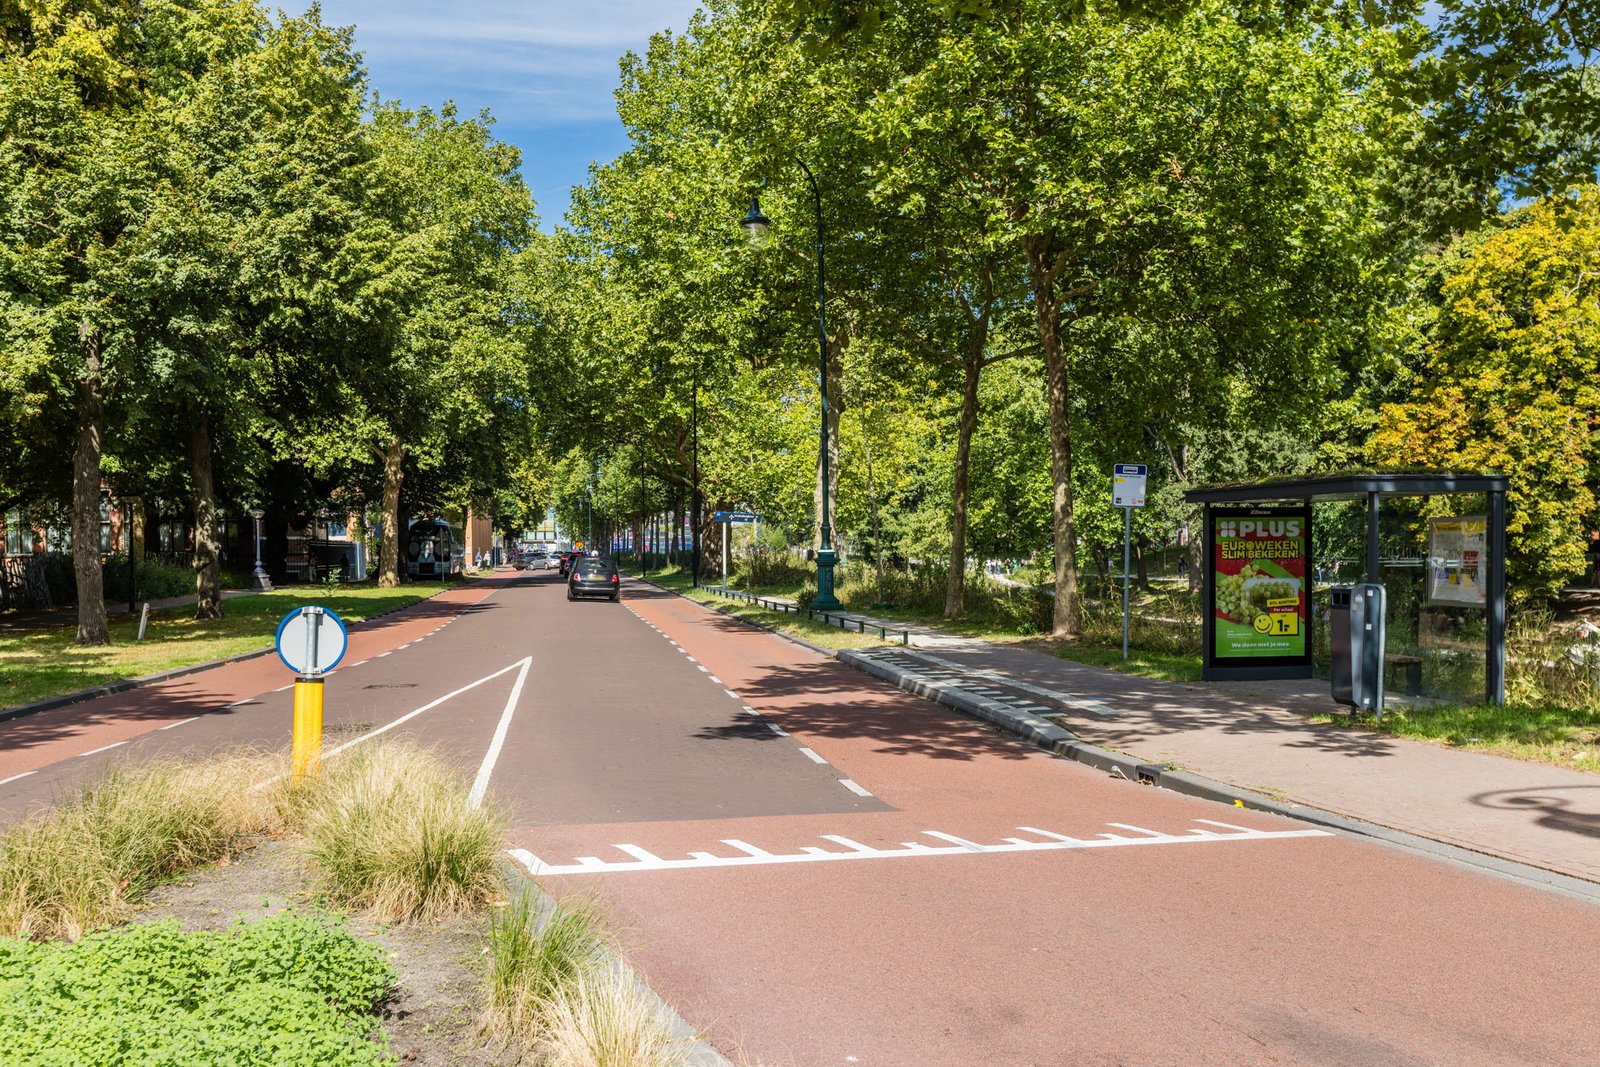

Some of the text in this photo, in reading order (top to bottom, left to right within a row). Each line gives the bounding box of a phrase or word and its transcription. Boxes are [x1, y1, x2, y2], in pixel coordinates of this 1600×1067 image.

[1240, 520, 1300, 537] PLUS
[1221, 550, 1299, 559] SLIM BEKEKEN!
